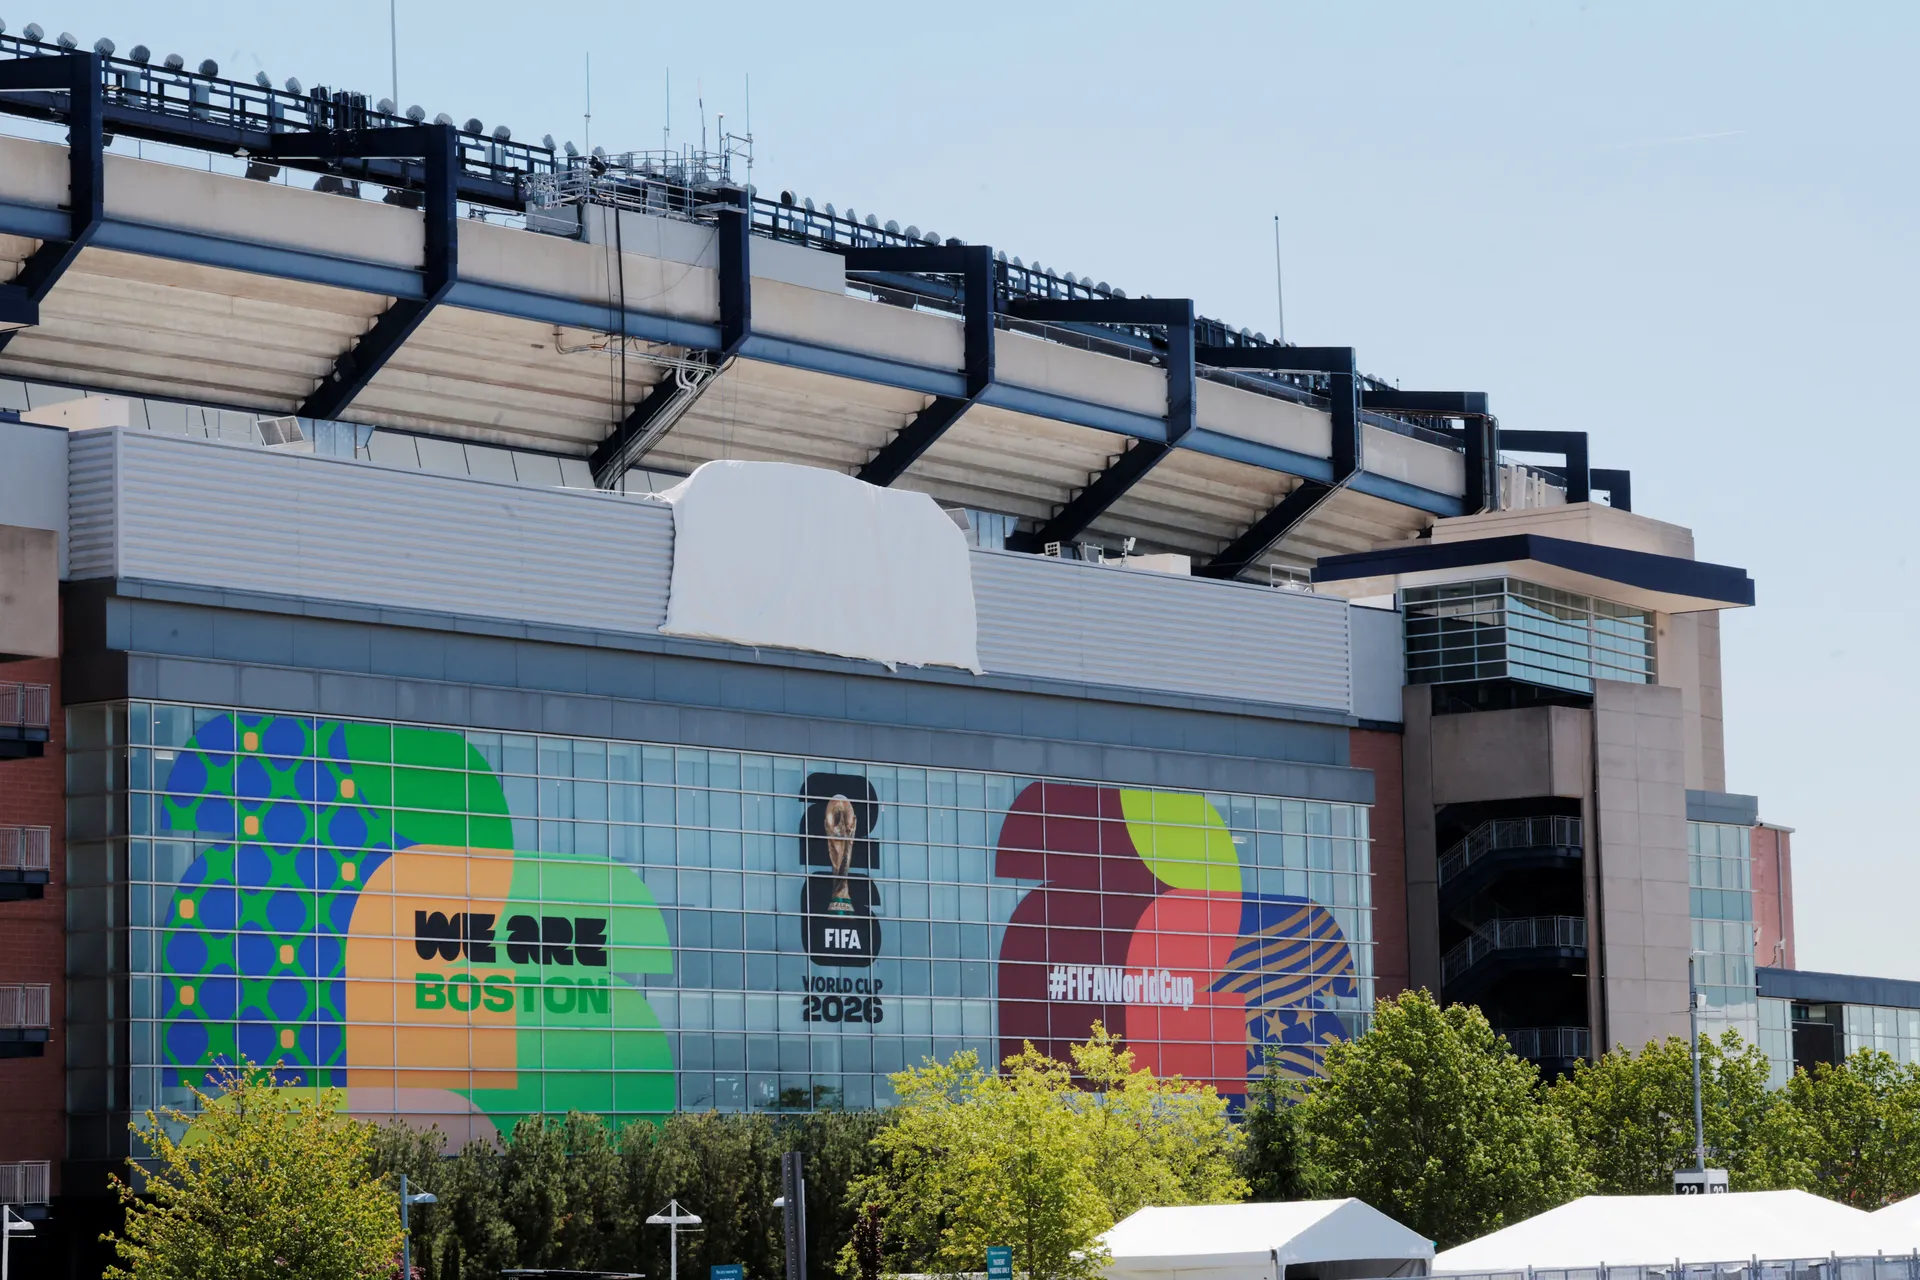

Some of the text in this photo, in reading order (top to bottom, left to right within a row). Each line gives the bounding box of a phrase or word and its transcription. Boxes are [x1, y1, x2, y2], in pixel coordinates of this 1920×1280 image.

[415, 910, 607, 967] WE ARE
[824, 928, 862, 949] FIFA
[415, 973, 610, 1014] BOSTON
[802, 975, 883, 995] WORLD CUP
[1049, 965, 1194, 1011] #FIFAWorldCup
[802, 994, 884, 1024] 2026
